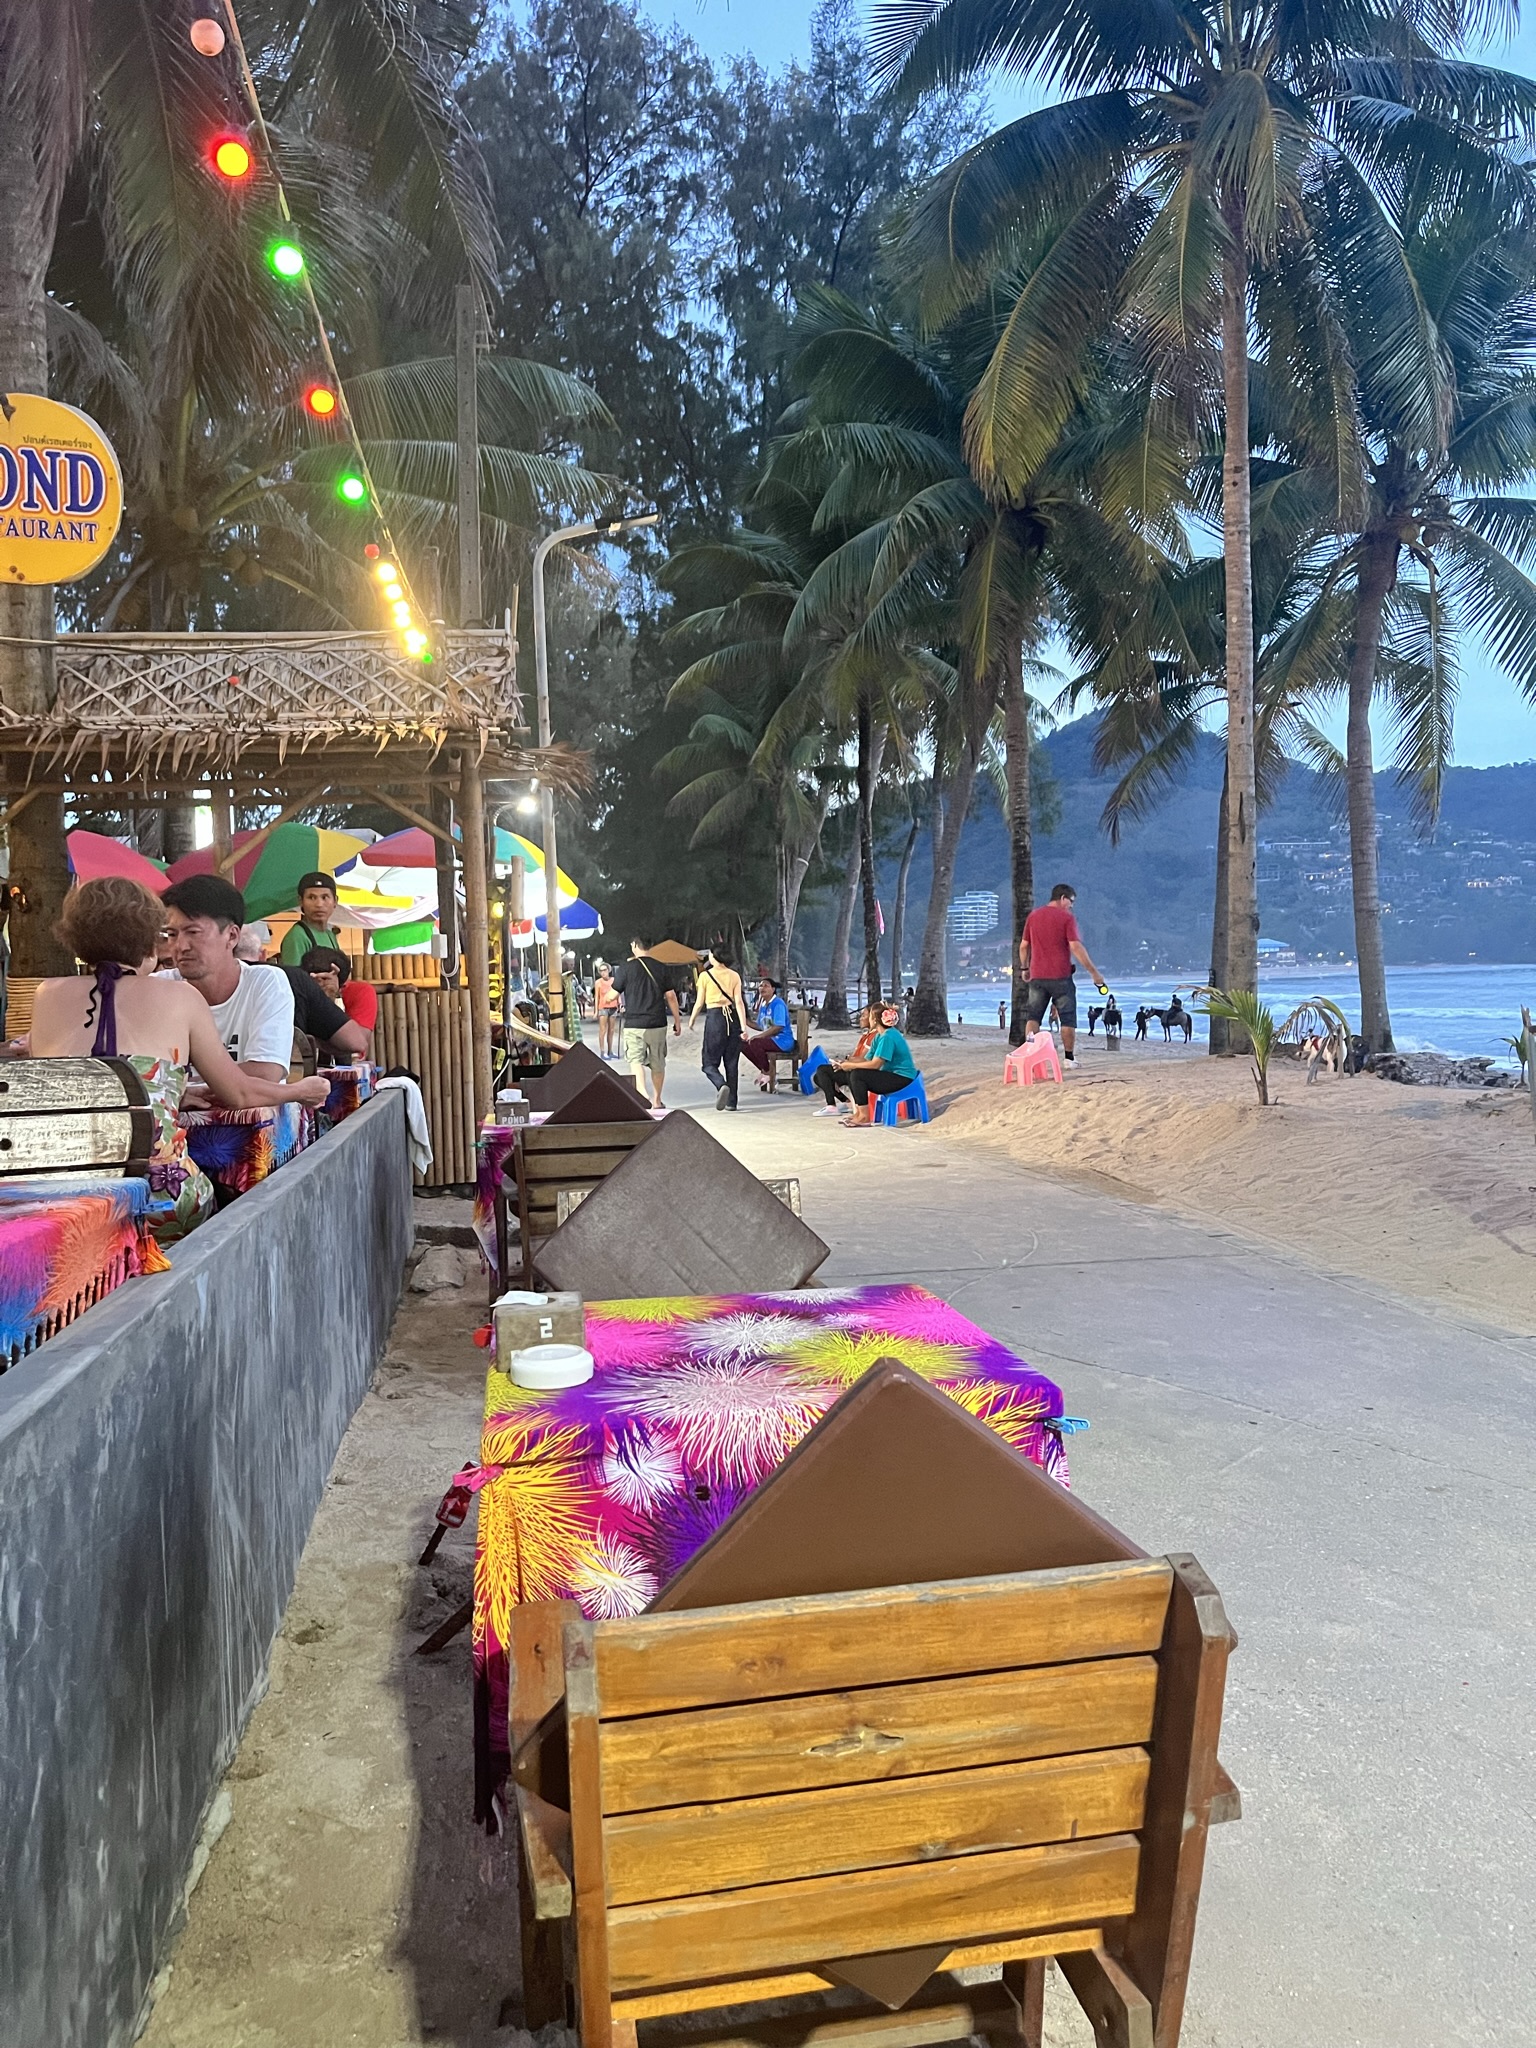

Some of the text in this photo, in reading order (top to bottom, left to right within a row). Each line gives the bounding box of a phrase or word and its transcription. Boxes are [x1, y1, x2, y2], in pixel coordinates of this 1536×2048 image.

[0, 518, 98, 542] AURANT
[509, 1108, 515, 1117] 1
[502, 1116, 525, 1125] POND
[539, 1317, 553, 1338] 2
